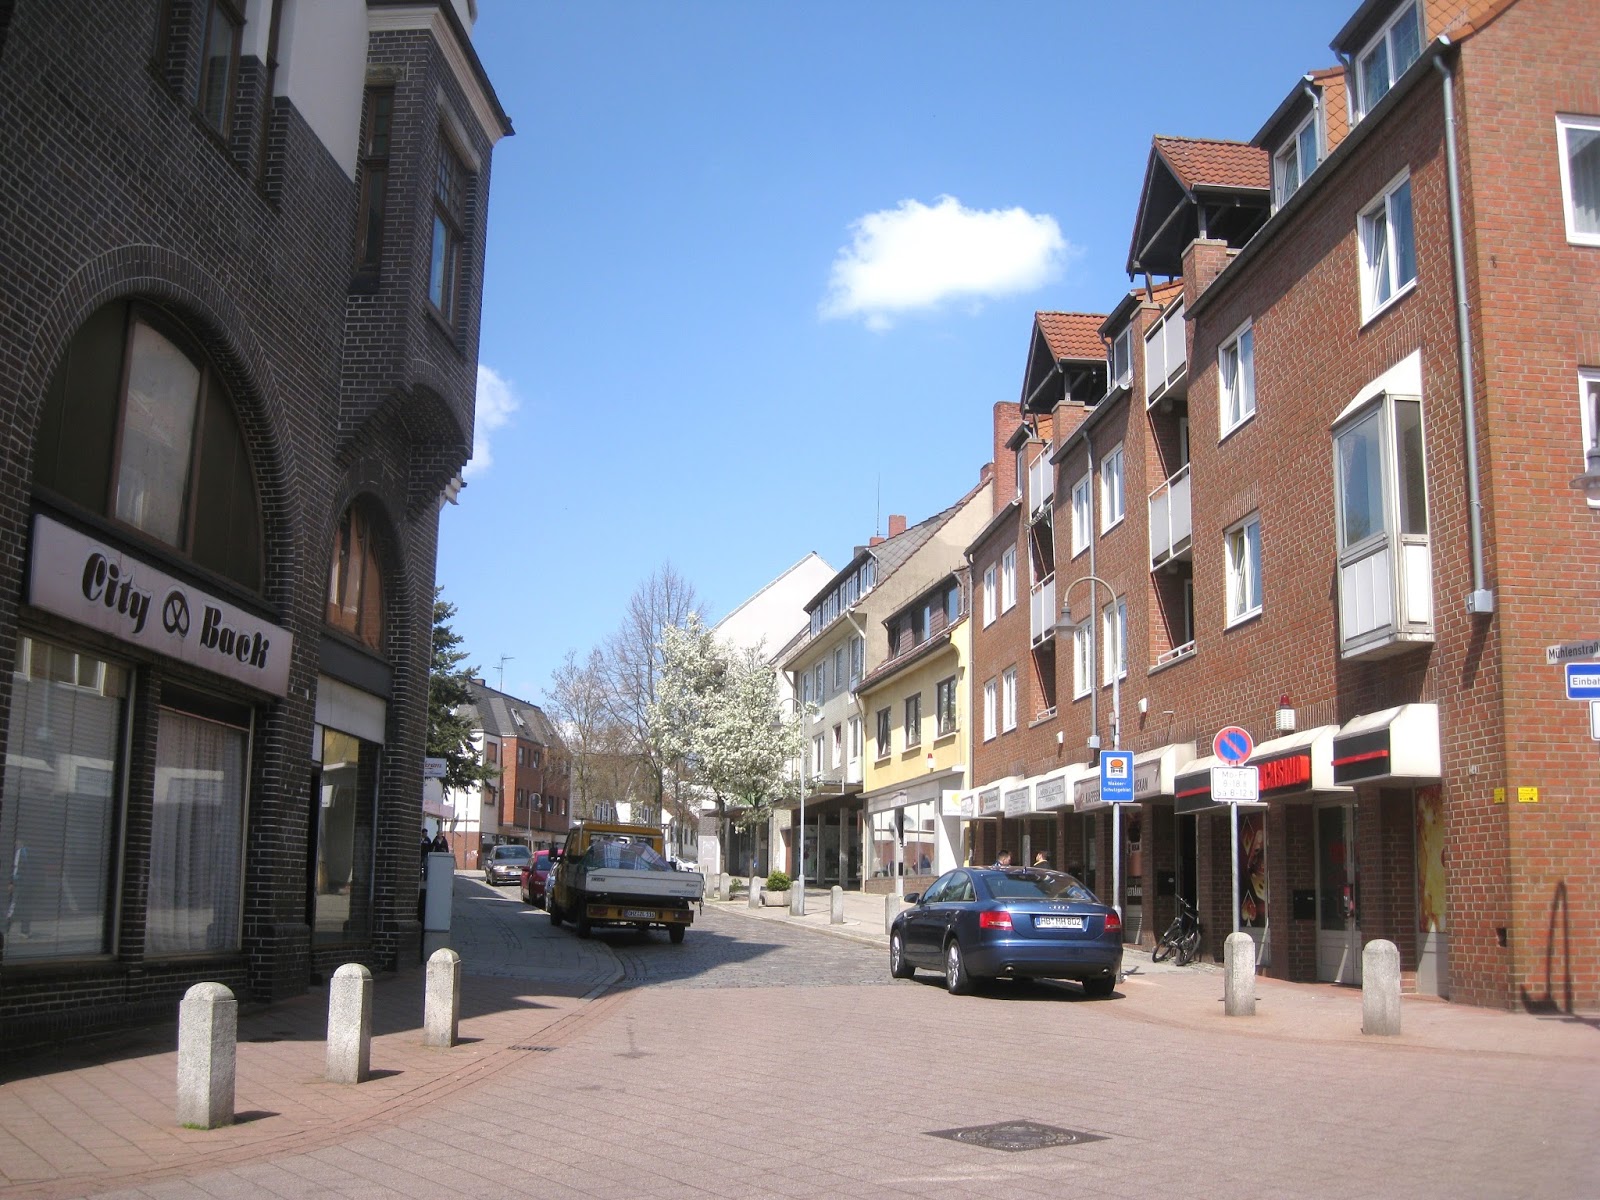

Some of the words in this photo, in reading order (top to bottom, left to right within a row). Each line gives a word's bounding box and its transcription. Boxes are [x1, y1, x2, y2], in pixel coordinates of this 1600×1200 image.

[82, 552, 152, 634] City
[199, 604, 271, 669] Back
[1548, 641, 1600, 659] Mühlenstraß
